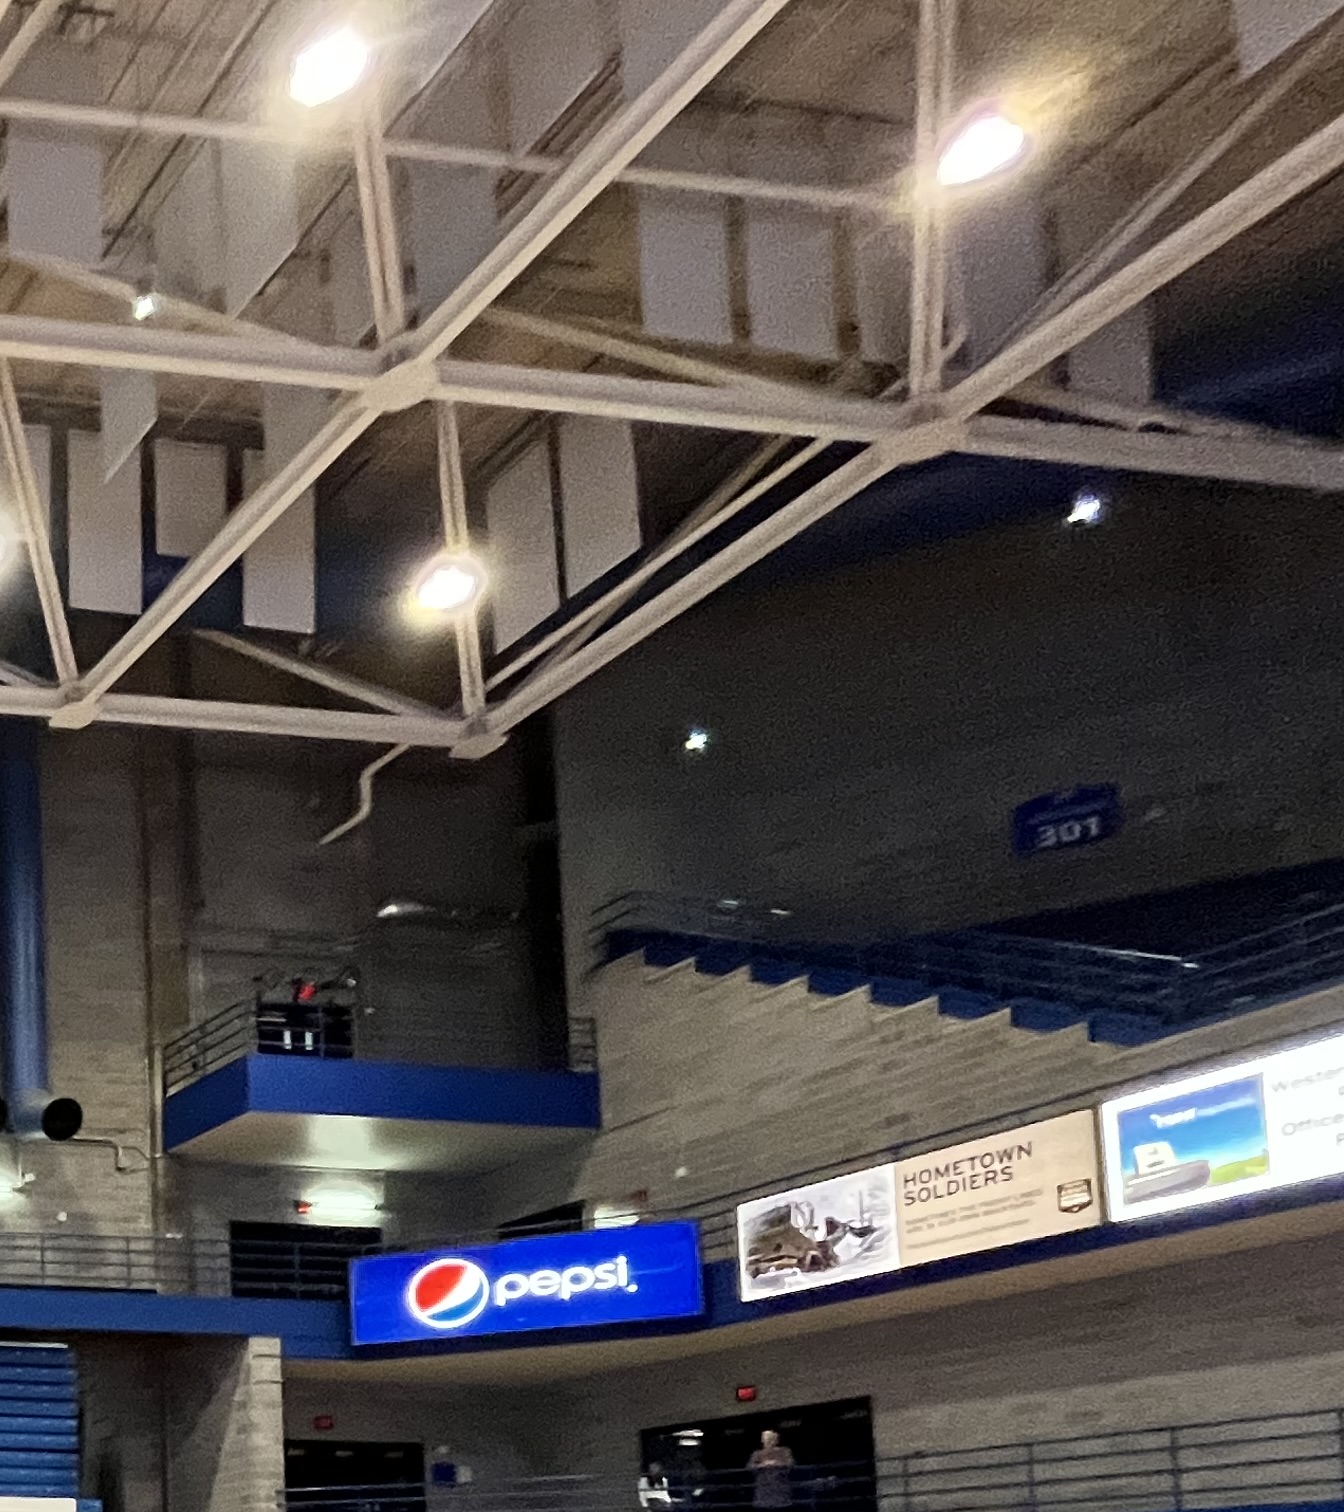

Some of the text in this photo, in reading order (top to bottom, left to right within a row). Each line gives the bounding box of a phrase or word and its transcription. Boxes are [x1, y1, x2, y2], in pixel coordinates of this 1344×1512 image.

[1037, 816, 1099, 848] 301
[903, 1140, 1033, 1190] HOMETOWN
[904, 1165, 1014, 1207] SOLDIERS
[494, 1254, 630, 1307] pepsi
